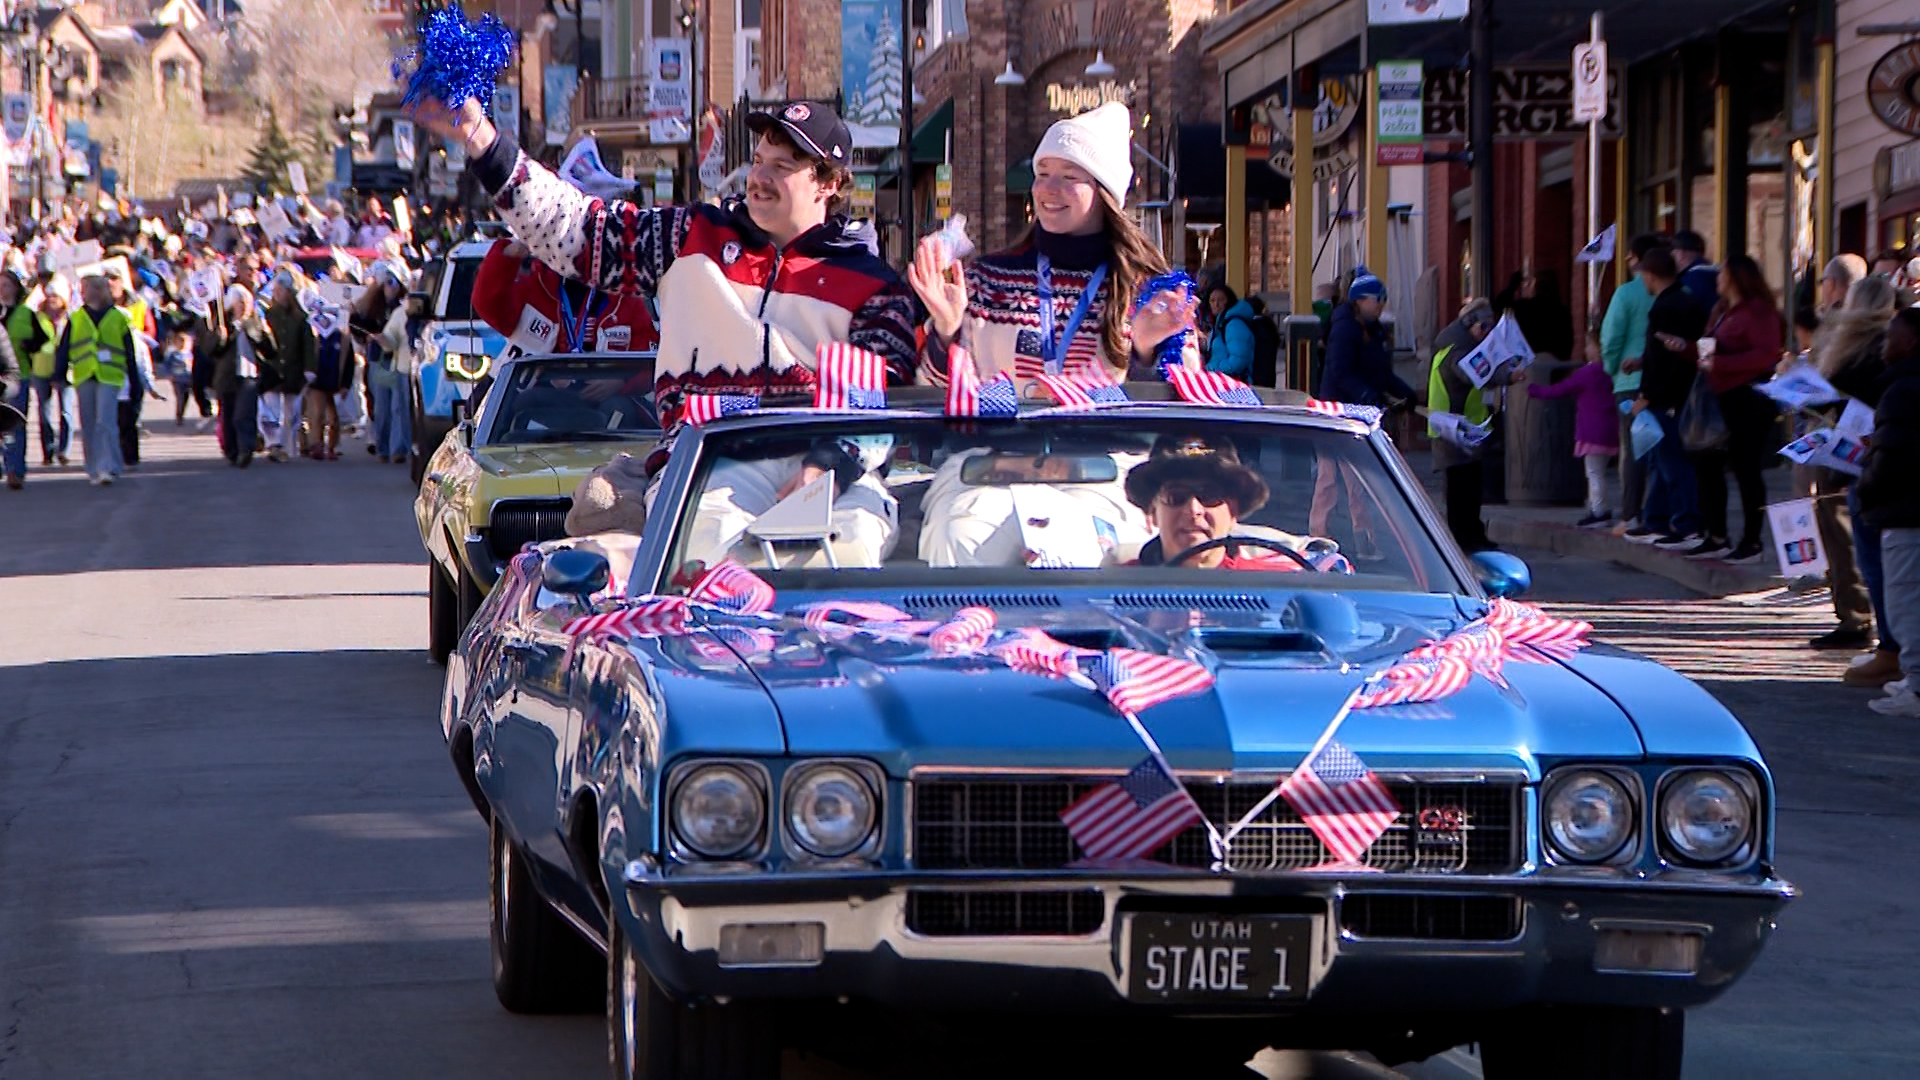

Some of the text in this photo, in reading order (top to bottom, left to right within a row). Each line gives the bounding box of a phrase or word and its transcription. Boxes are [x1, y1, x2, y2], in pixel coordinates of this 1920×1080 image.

[529, 316, 551, 339] USA
[1191, 920, 1252, 940] UTAH
[1146, 946, 1292, 992] STAGE 1
